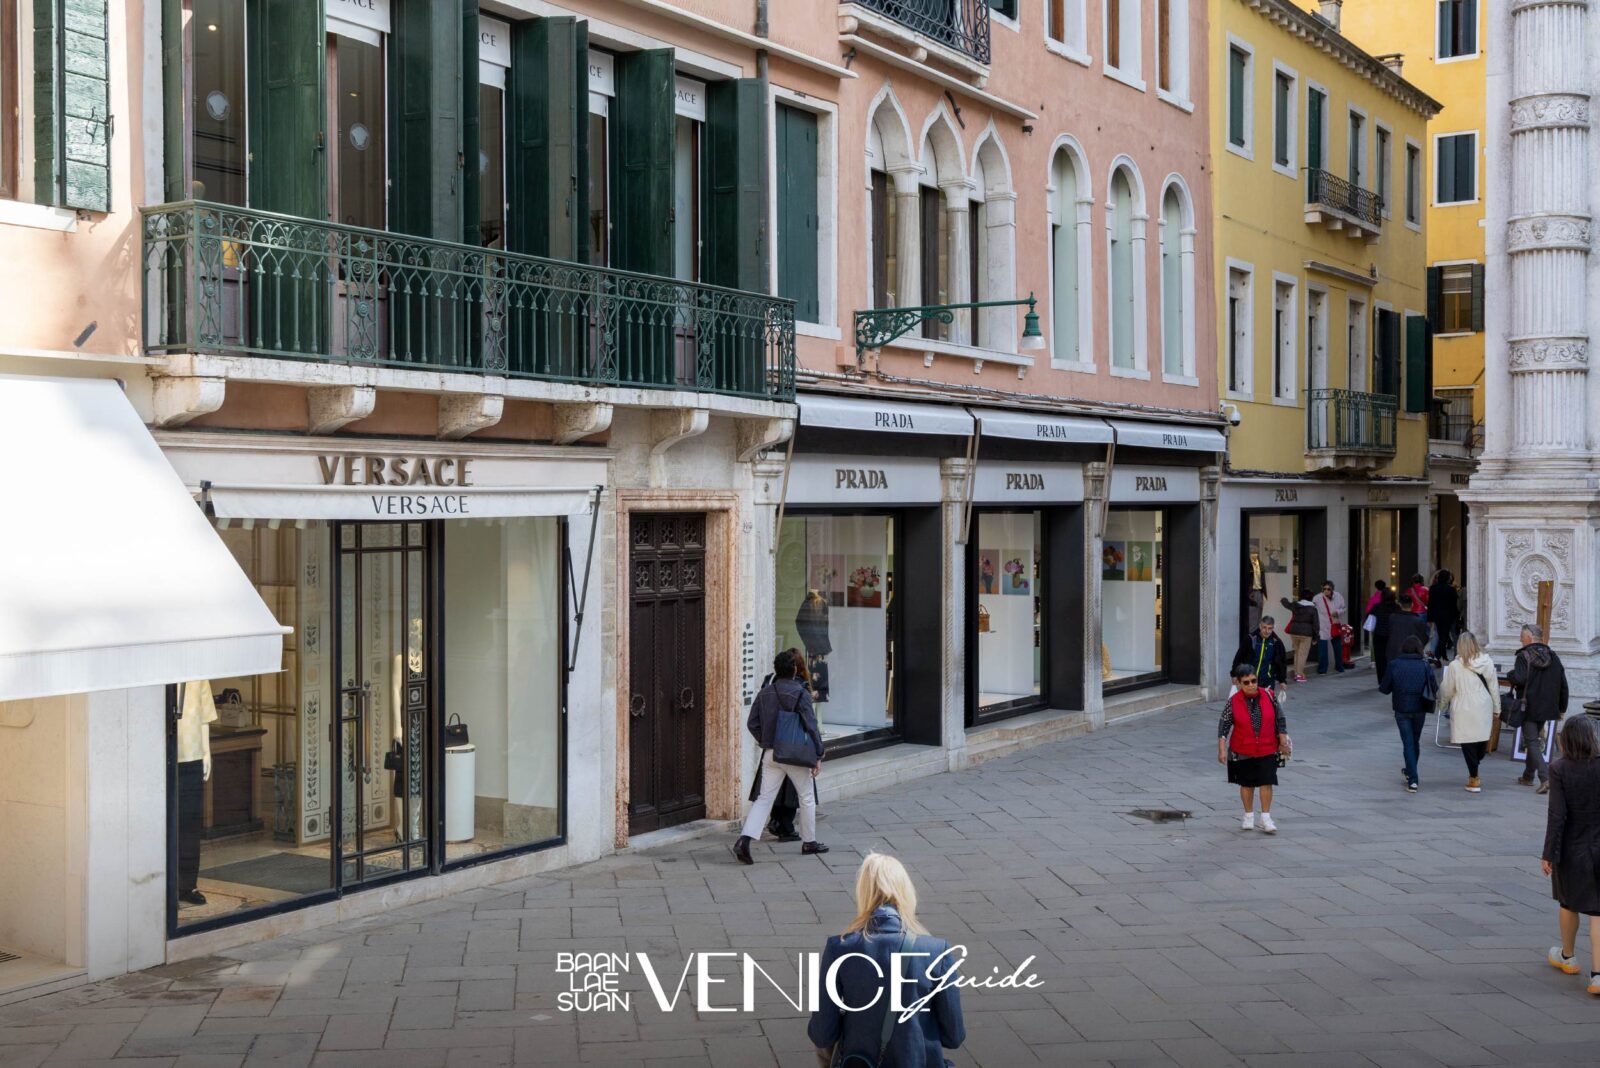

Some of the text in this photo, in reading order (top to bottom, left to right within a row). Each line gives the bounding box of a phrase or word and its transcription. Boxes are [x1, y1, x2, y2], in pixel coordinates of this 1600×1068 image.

[874, 411, 914, 429] PRADA
[1036, 424, 1067, 439] PRADA
[1162, 433, 1188, 447] PRADA
[318, 456, 474, 486] VERSACE
[835, 469, 888, 490] PRADA
[1006, 473, 1045, 491] PRADA
[1135, 476, 1168, 492] PRADA
[371, 495, 469, 514] VERSACE
